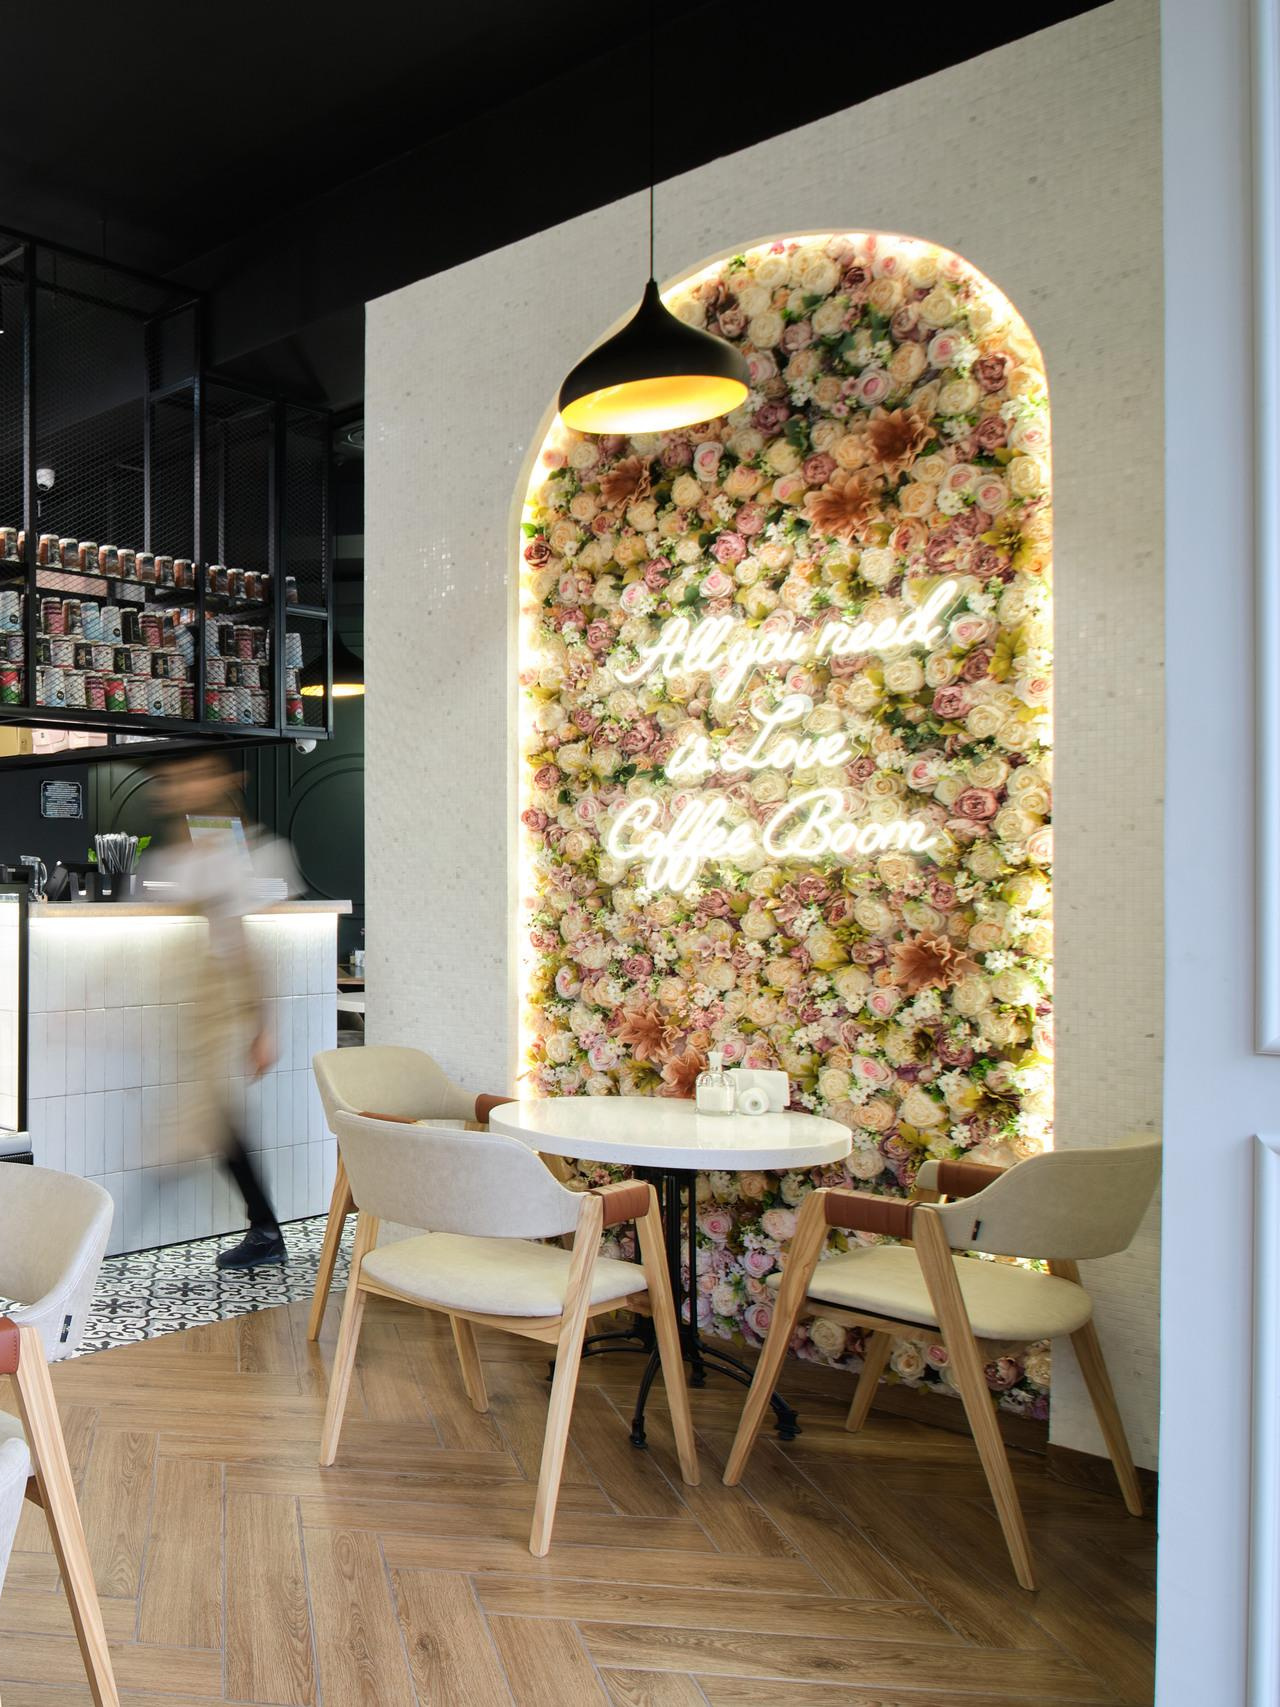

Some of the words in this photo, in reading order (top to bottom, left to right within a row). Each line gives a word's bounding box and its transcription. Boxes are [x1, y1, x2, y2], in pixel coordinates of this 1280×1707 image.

[613, 614, 738, 686] All
[716, 628, 806, 700] you
[815, 580, 958, 657] need
[665, 730, 715, 779] is
[720, 693, 852, 772] Love
[608, 798, 754, 892] Coffee
[762, 787, 937, 858] Boom
